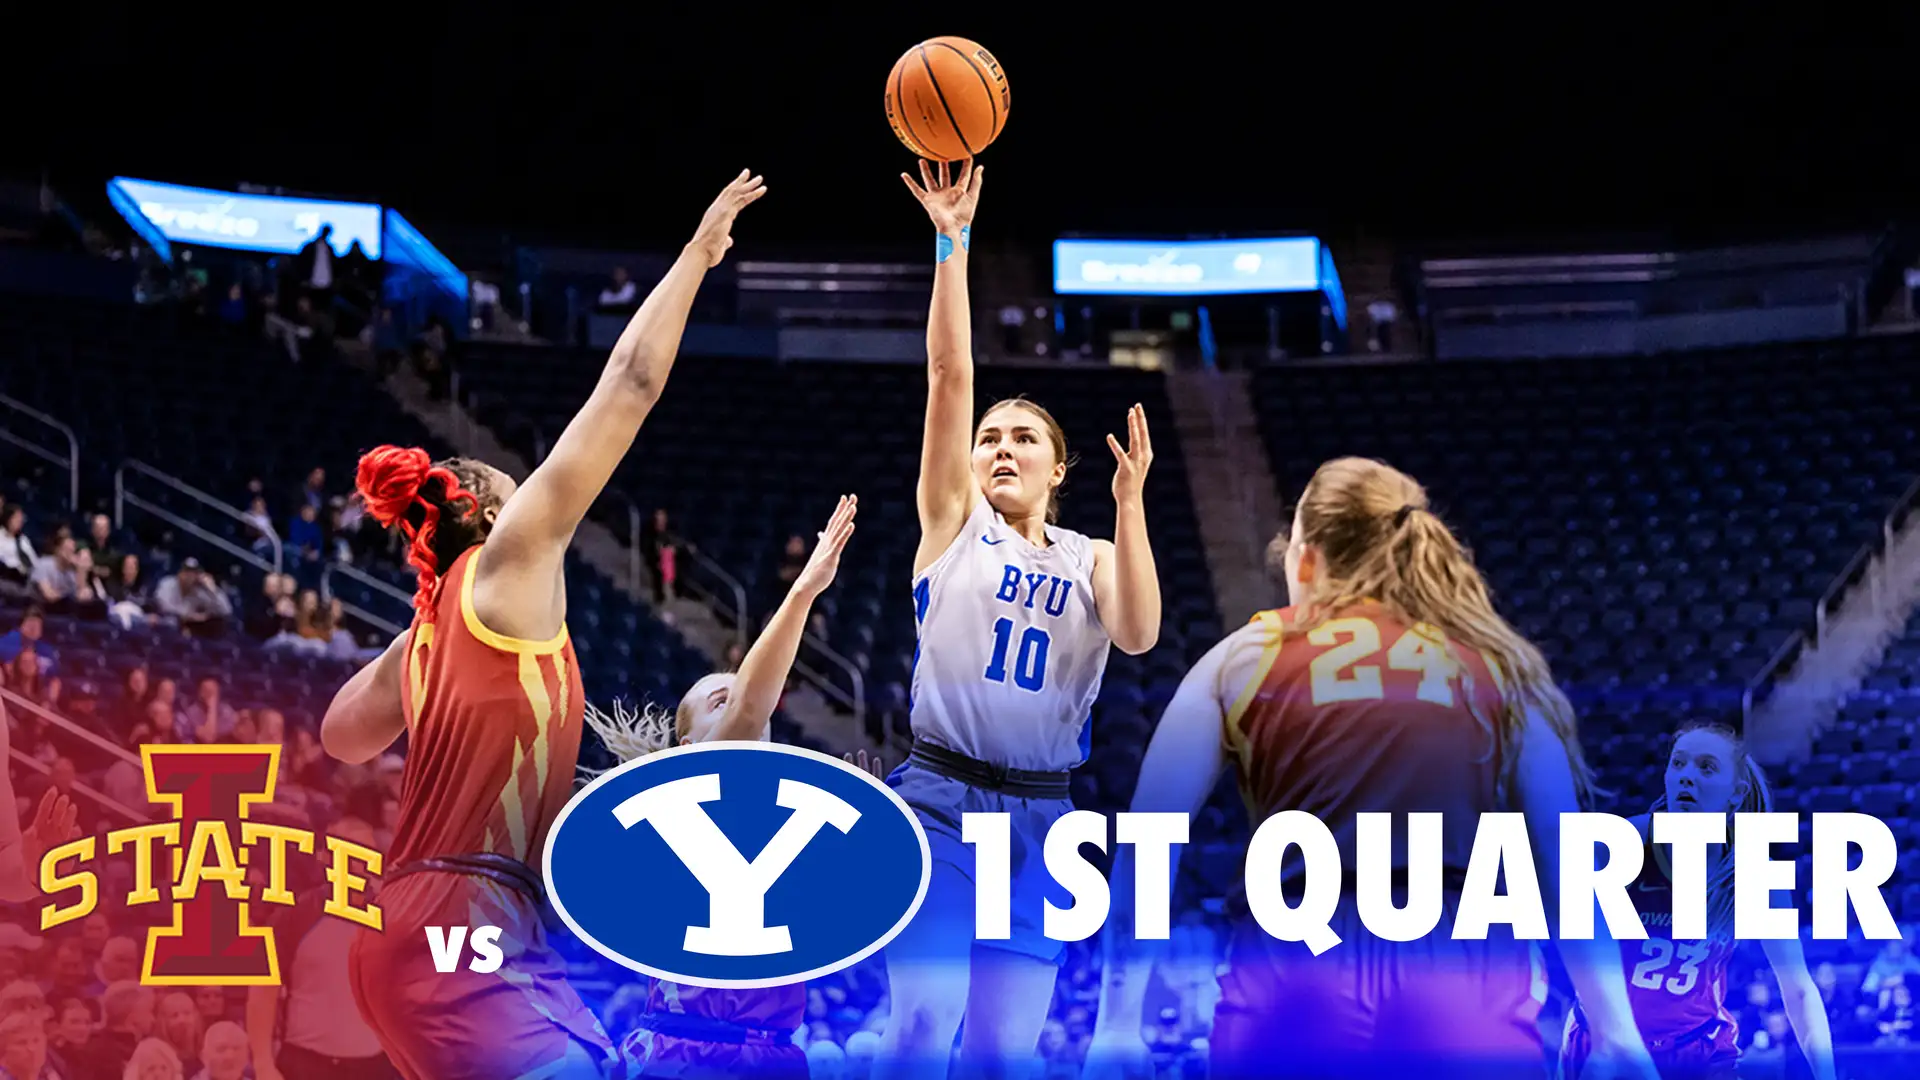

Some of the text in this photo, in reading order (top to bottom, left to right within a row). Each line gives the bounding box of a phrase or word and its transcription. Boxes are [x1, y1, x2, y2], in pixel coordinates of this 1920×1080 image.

[996, 564, 1073, 617] BYU
[984, 616, 1051, 693] 10
[1307, 617, 1460, 708] 24
[1631, 936, 1710, 996] 23
